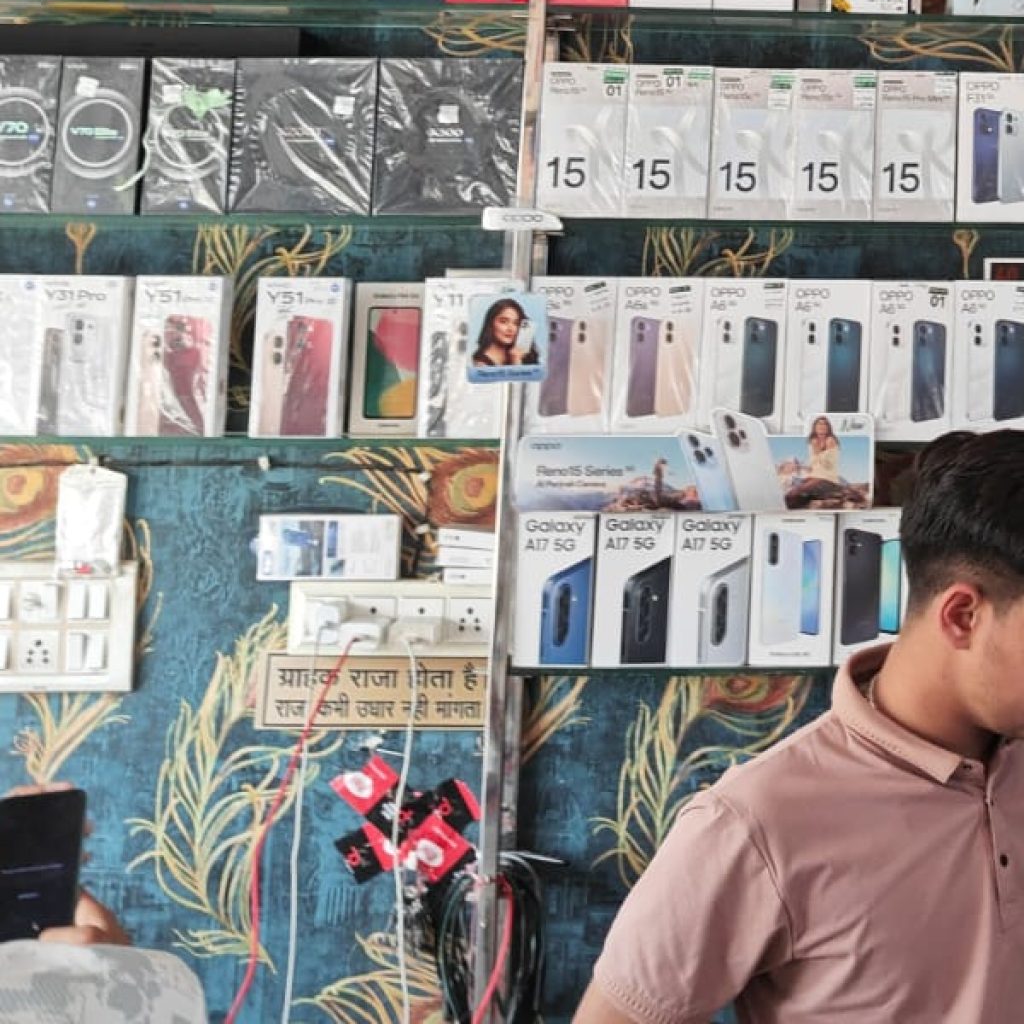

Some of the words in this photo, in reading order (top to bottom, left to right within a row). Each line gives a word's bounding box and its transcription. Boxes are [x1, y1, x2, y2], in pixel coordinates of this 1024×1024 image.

[547, 157, 586, 189] 15
[633, 159, 670, 190] 15
[720, 162, 756, 192] 15
[801, 162, 839, 192] 15
[883, 162, 920, 193] 15
[267, 291, 304, 305] Y51
[584, 465, 623, 477] Series
[525, 519, 586, 537] Galaxy
[605, 519, 665, 536] Galaxy
[682, 519, 742, 536] Galaxy
[525, 537, 549, 551] A17
[553, 538, 576, 552] 5G
[605, 537, 629, 551] A17
[634, 537, 656, 551] 5G
[682, 537, 706, 551] A17
[709, 537, 732, 551] 5G
[348, 668, 399, 689] राजा
